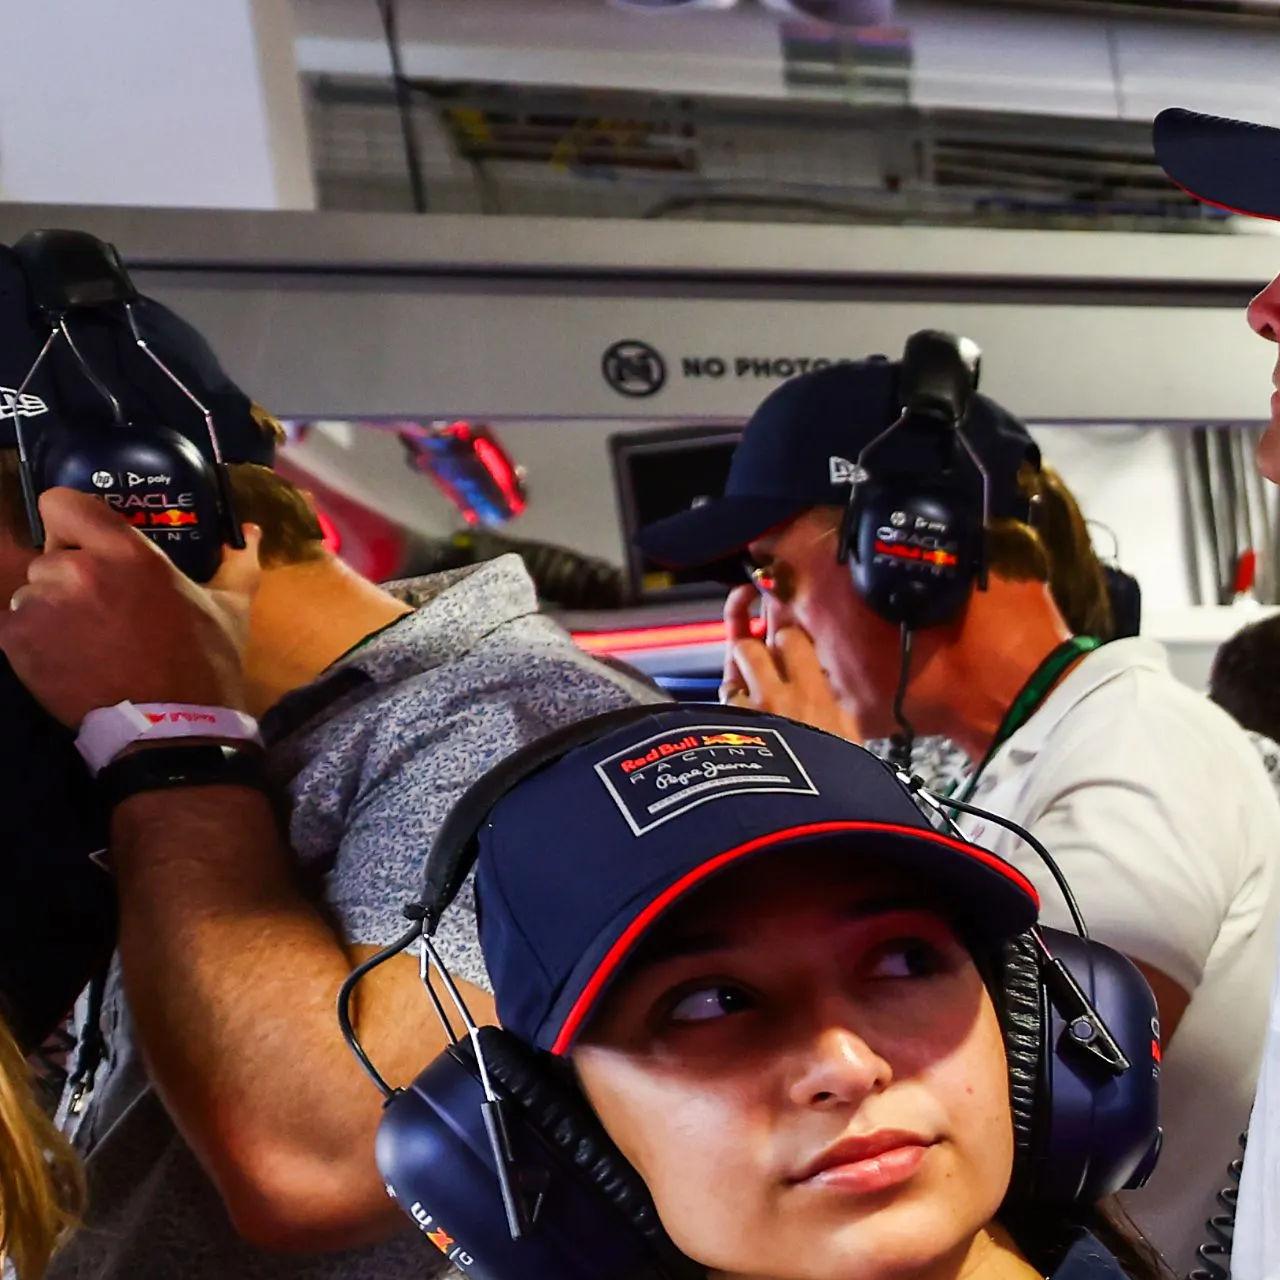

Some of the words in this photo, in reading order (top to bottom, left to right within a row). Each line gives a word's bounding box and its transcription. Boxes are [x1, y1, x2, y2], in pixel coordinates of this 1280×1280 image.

[682, 357, 726, 379] NO
[103, 493, 193, 508] RACLE
[620, 745, 659, 774] Red
[658, 736, 700, 758] Bull
[630, 747, 774, 785] RACING
